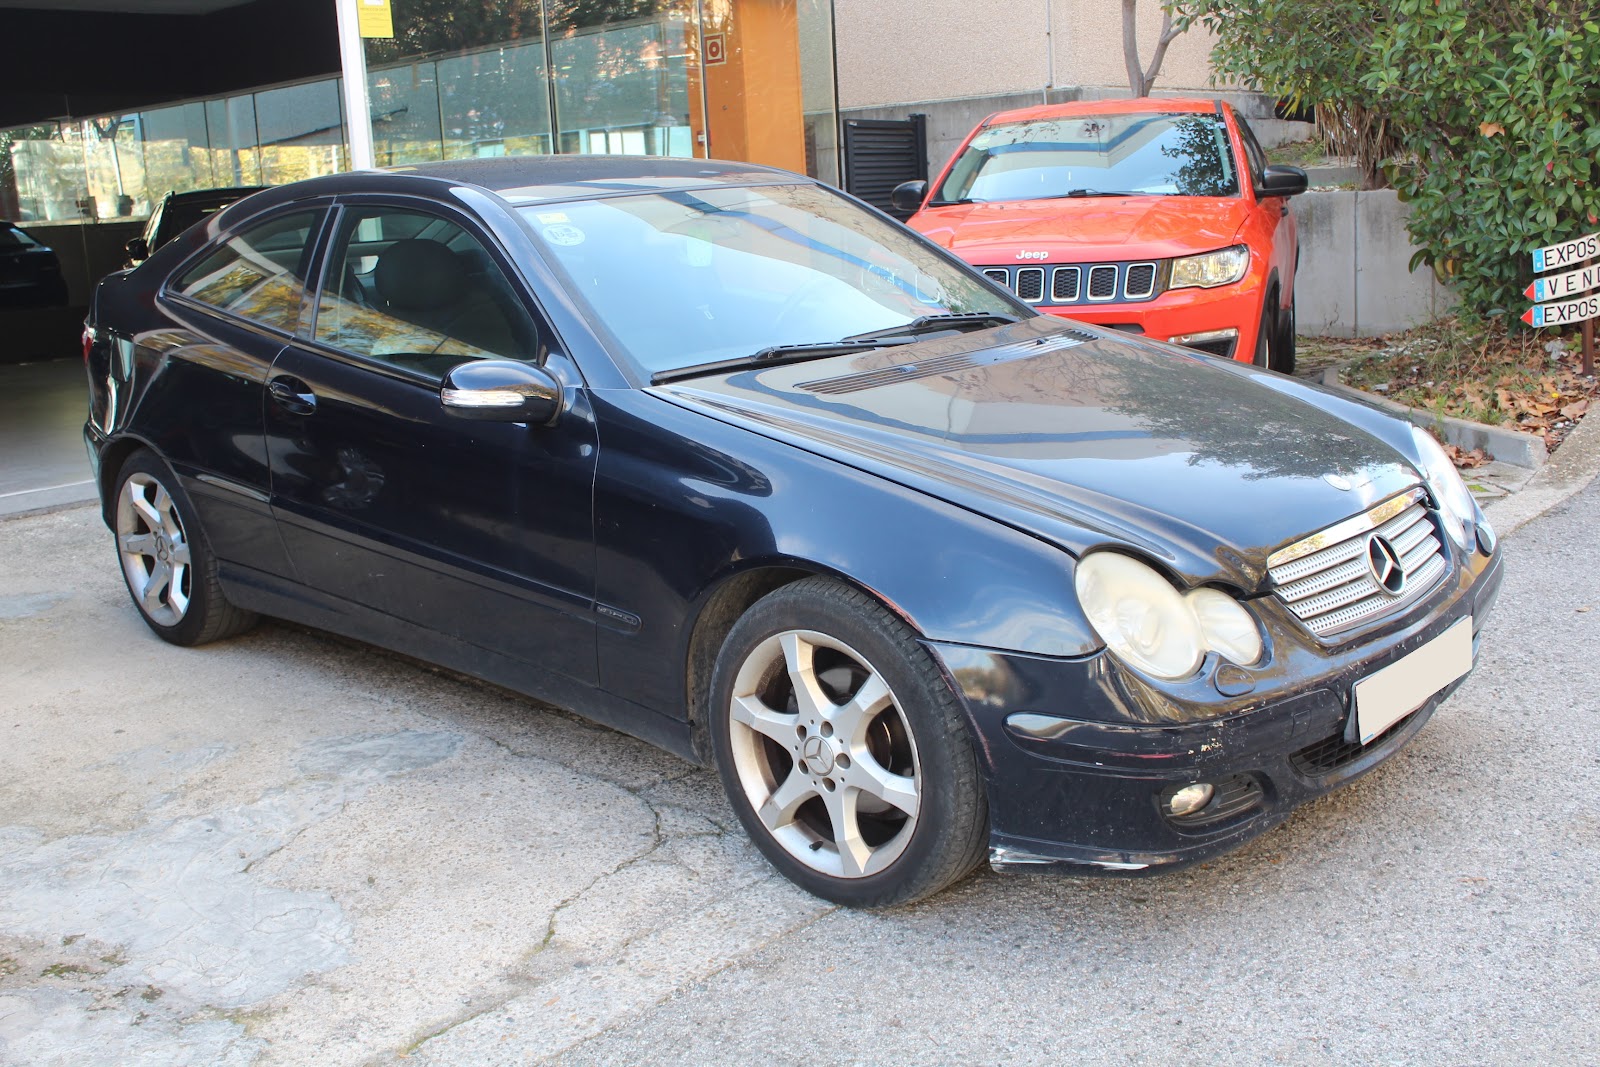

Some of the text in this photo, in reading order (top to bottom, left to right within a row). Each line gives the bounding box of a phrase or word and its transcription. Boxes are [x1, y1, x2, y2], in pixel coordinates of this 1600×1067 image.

[1015, 250, 1049, 261] Jeep
[1544, 238, 1597, 267] EXPOS
[1548, 267, 1600, 296] VEN
[1544, 298, 1598, 323] EXPOS
